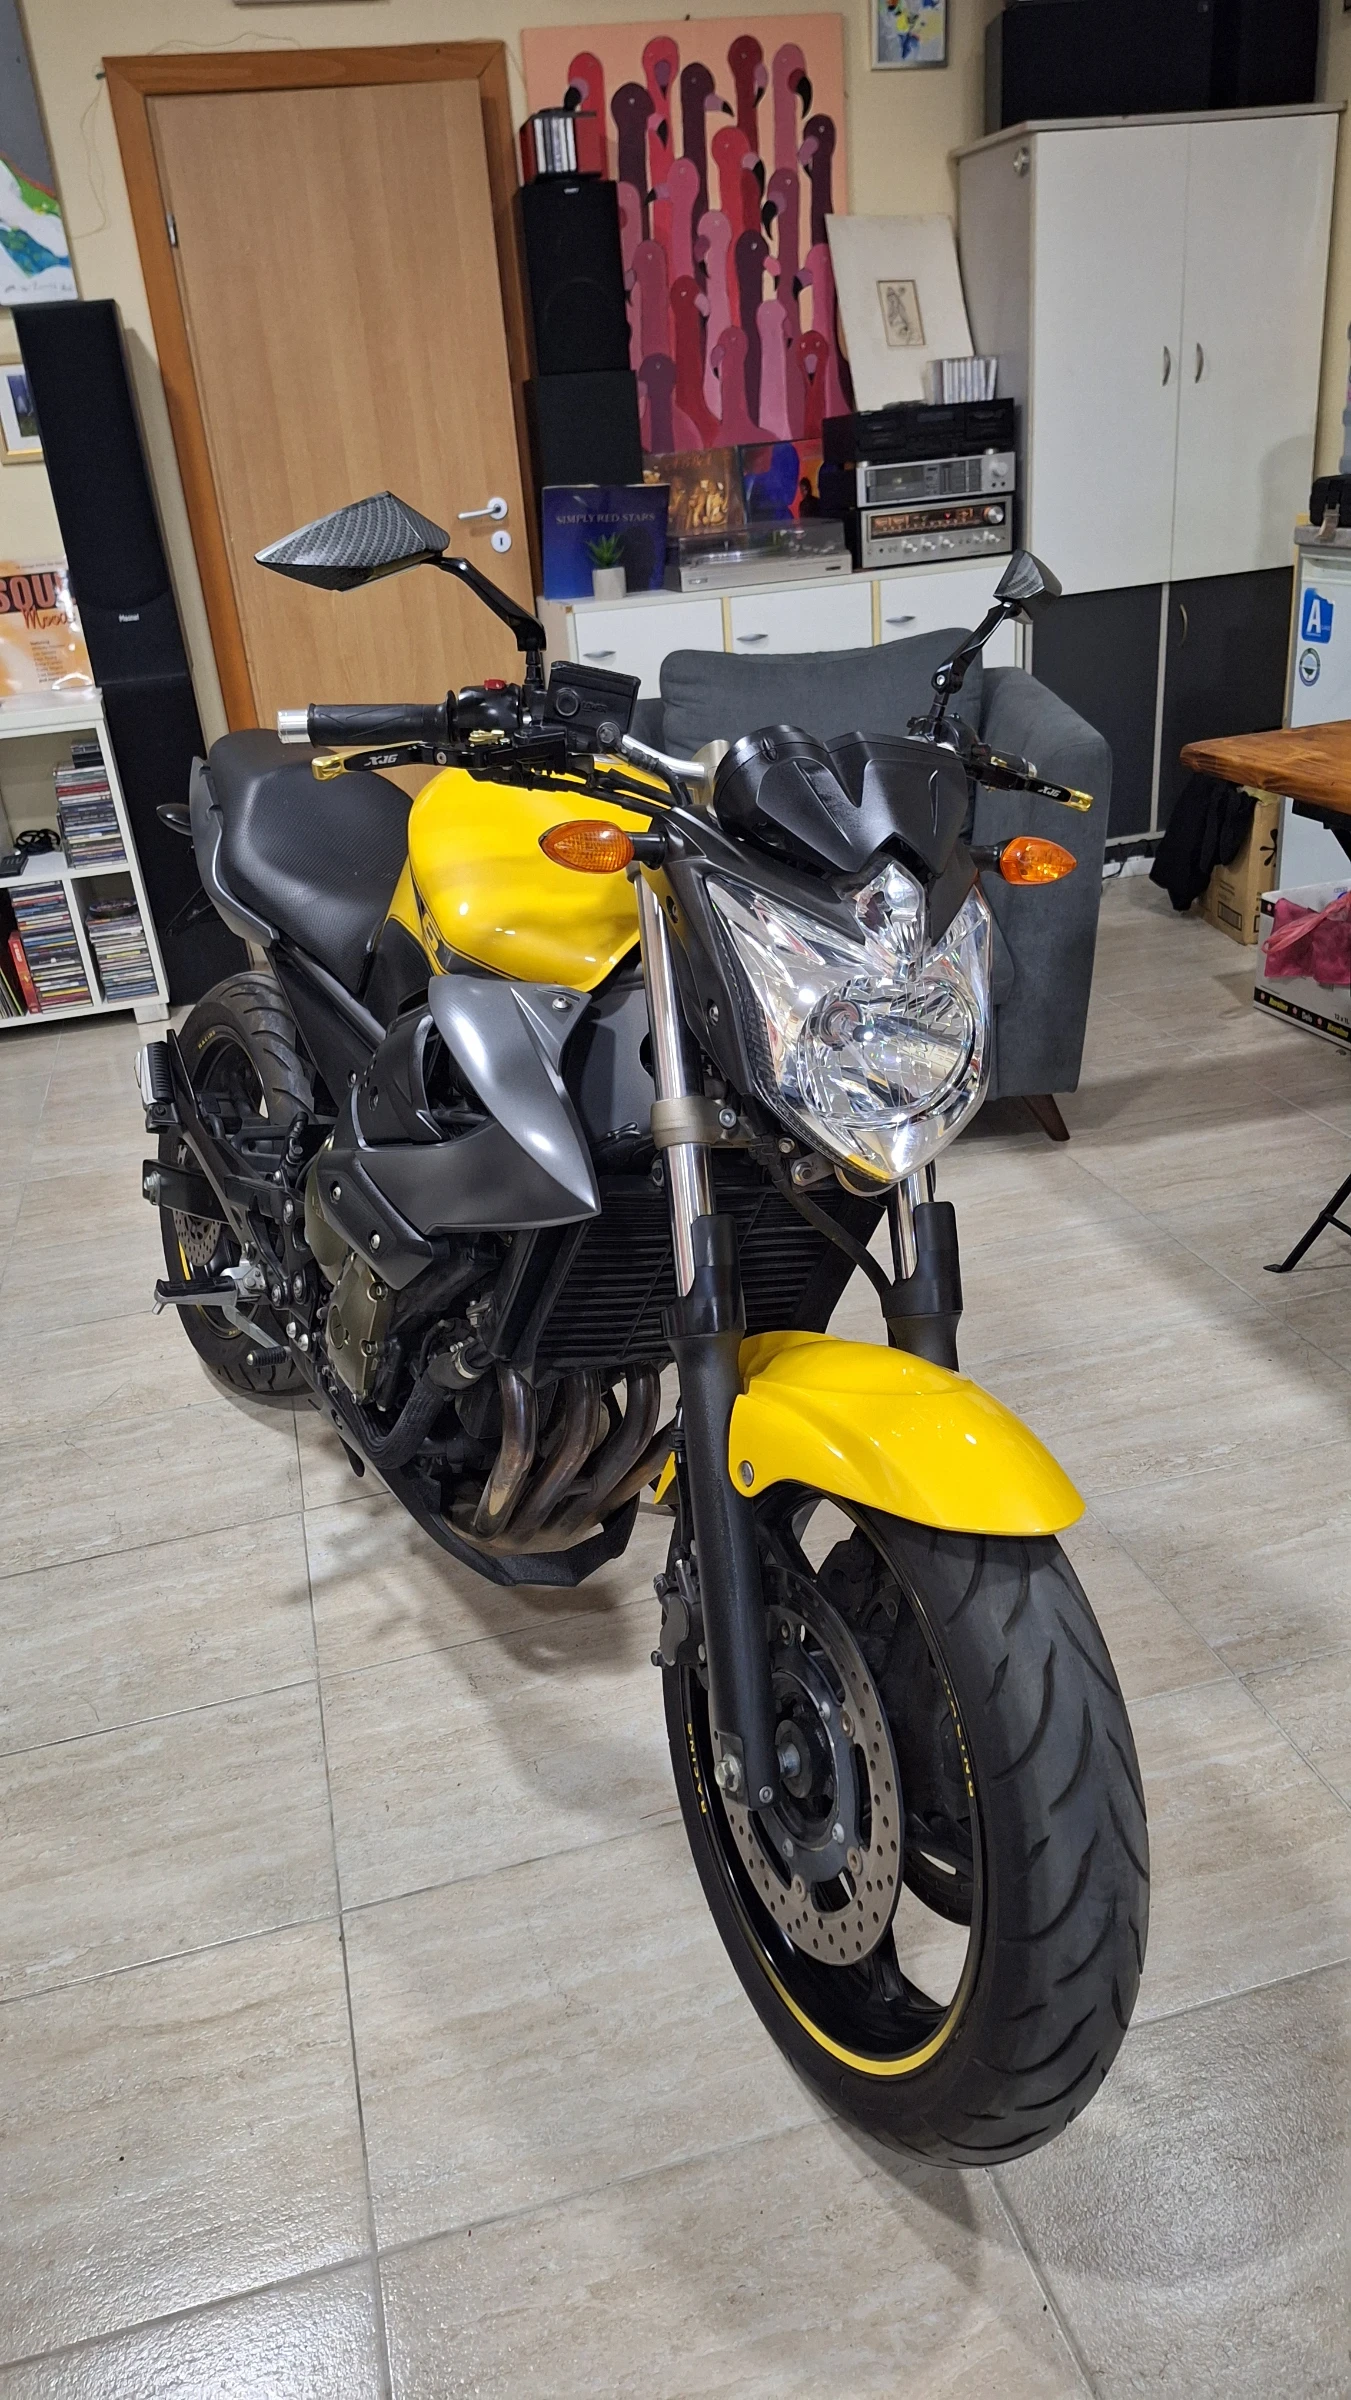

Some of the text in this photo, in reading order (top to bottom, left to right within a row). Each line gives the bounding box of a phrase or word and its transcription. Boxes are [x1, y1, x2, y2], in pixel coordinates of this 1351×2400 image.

[556, 512, 655, 524] SIMPLY RED STARS
[0, 573, 76, 613] SOU
[1306, 599, 1321, 633] A
[364, 753, 398, 766] XJ6
[1037, 785, 1062, 797] XJ6
[687, 1723, 707, 1814] RACING
